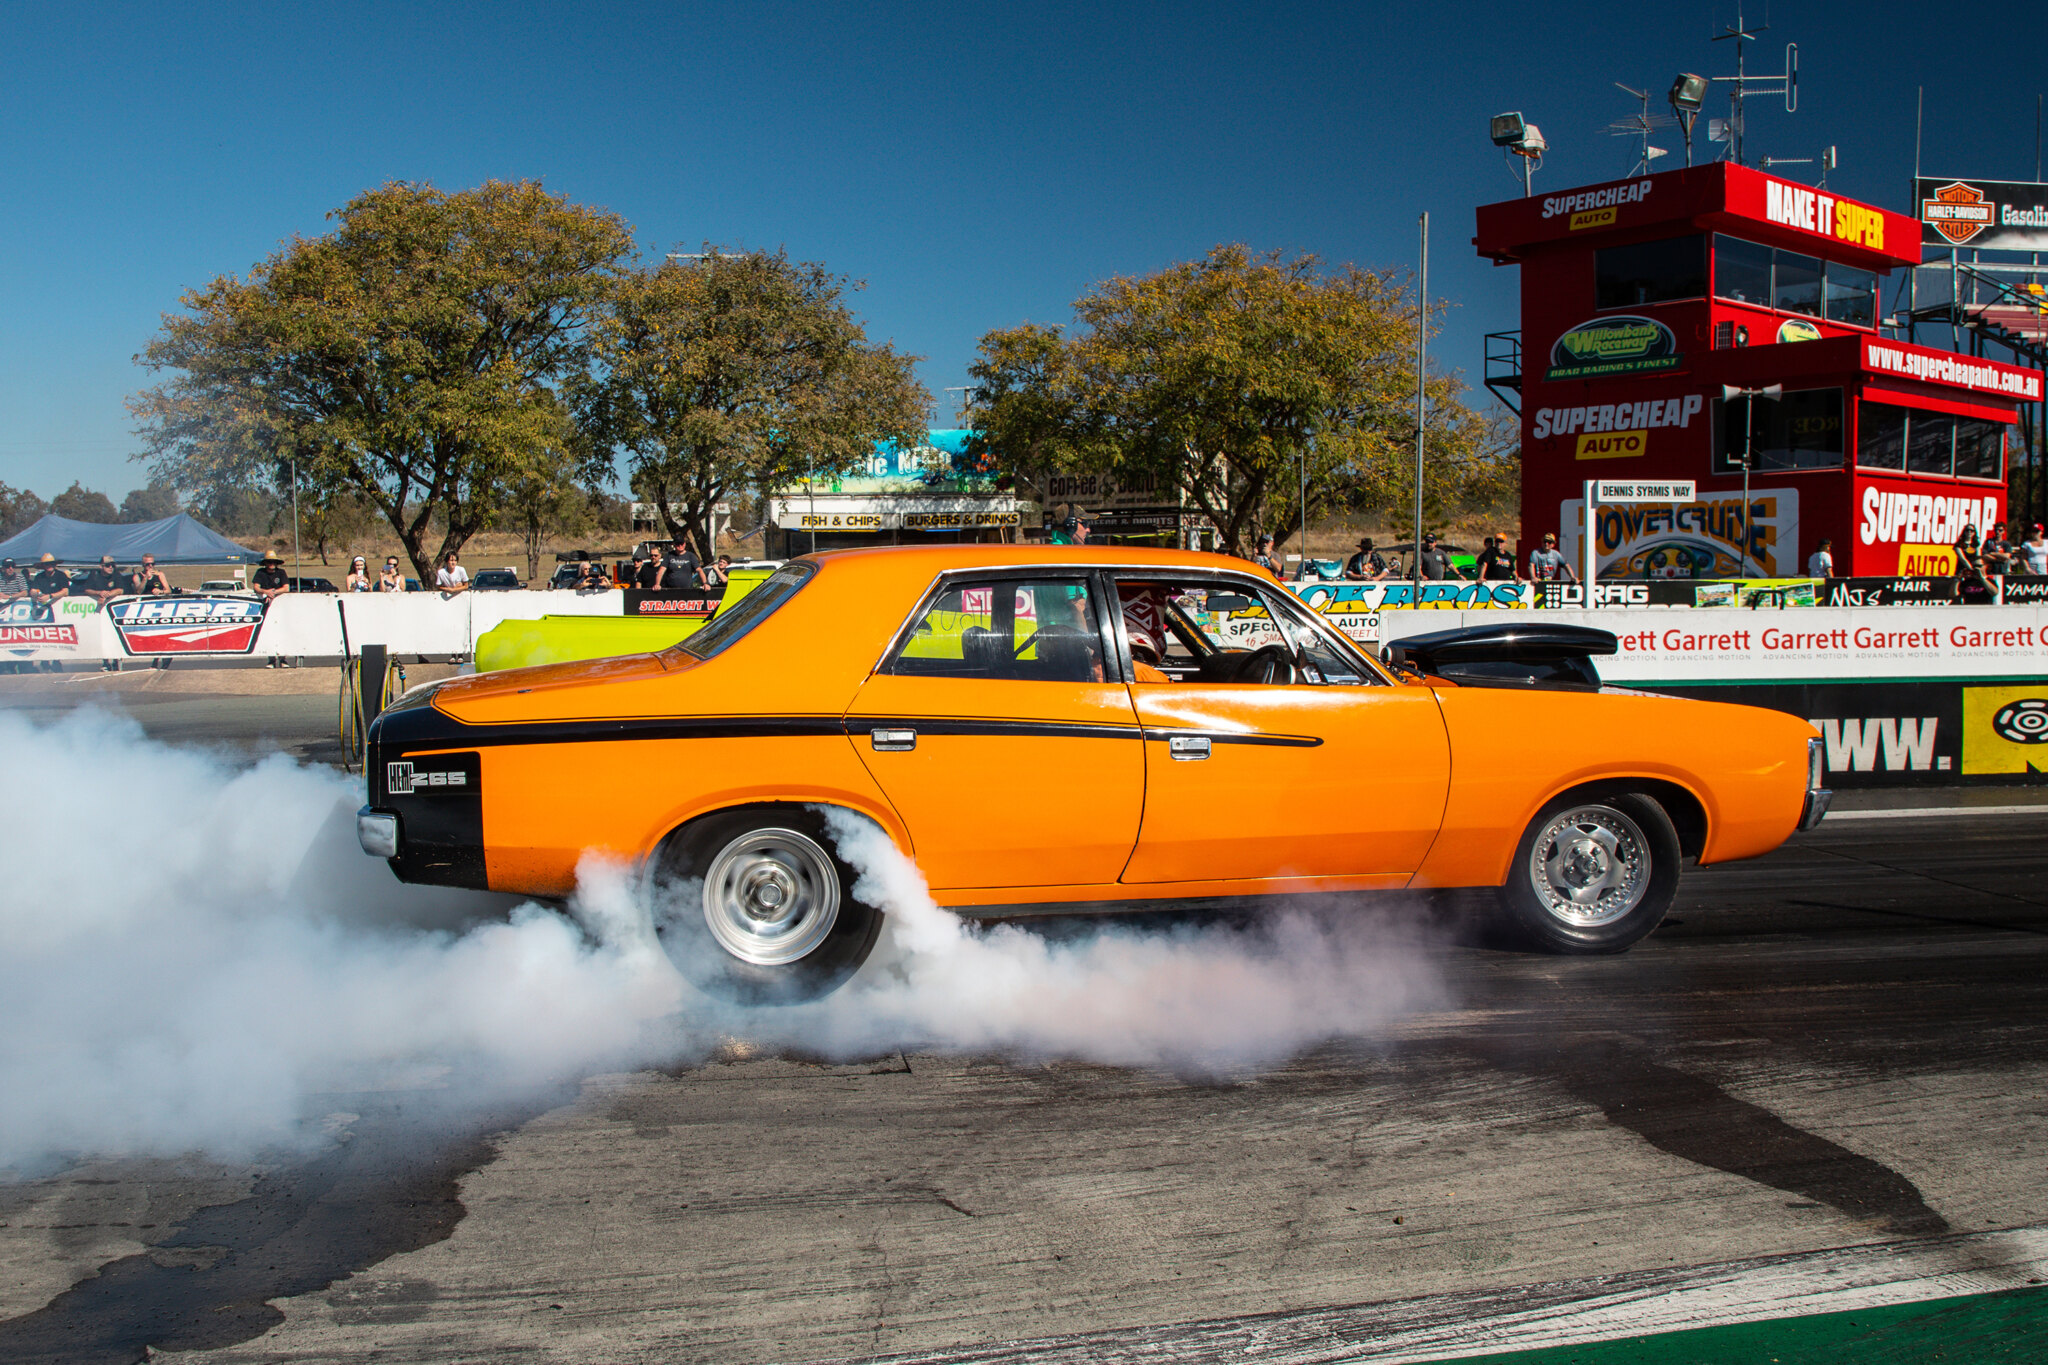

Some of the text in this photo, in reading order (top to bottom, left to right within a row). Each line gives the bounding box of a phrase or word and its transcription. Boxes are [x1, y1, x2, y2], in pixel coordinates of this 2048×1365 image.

[1541, 180, 1652, 218] SUPERCHEAP
[1942, 189, 1977, 203] MOTOR
[1574, 211, 1612, 226] AUTO
[1766, 180, 1884, 250] MAKE IT SUPER
[1927, 205, 1989, 220] HARLEY-DAVIDSON
[1943, 221, 1974, 238] CYCLES
[1563, 322, 1660, 354] Willowbank
[1592, 337, 1650, 356] Raceway
[1550, 368, 1580, 377] DRAG
[1637, 357, 1678, 369] FINEST
[1868, 344, 2039, 397] www.supercheapauto.com.au
[1533, 394, 1703, 440] SUPERCHEAP
[1582, 436, 1641, 454] AUTO
[1602, 485, 1691, 497] DENNIS SYRMIS WAY
[801, 516, 881, 526] FISH & CHIPS
[907, 513, 1018, 526] BURGERS & DRINKS
[1860, 486, 1998, 549] SUPERCHEAP
[1904, 555, 1950, 576] AUTO
[1560, 584, 1650, 604] DRAG
[1893, 581, 1931, 592] HAIR
[1376, 583, 1528, 610] BROS.
[62, 601, 96, 619] Kayo
[123, 602, 250, 618] IHRA
[639, 600, 704, 612] STRAIGHT
[122, 616, 254, 626] MOTORSPORTS
[1338, 617, 1379, 627] AUTO
[0, 627, 74, 641] UNDER
[1662, 629, 1750, 652] Garrett
[1761, 627, 1849, 650] Garrett
[1853, 627, 1940, 649] Garrett
[1950, 626, 2034, 648] Garrett
[1623, 654, 1657, 662] MOTION
[1663, 654, 1714, 662] ADVANCING
[1762, 653, 1812, 661] ADVANCING
[1815, 652, 1849, 660] MOTION
[1855, 652, 1904, 660] ADVANCING
[1907, 651, 1940, 659] MOTION
[1808, 717, 1952, 772] WW.
[410, 771, 466, 786] 265
